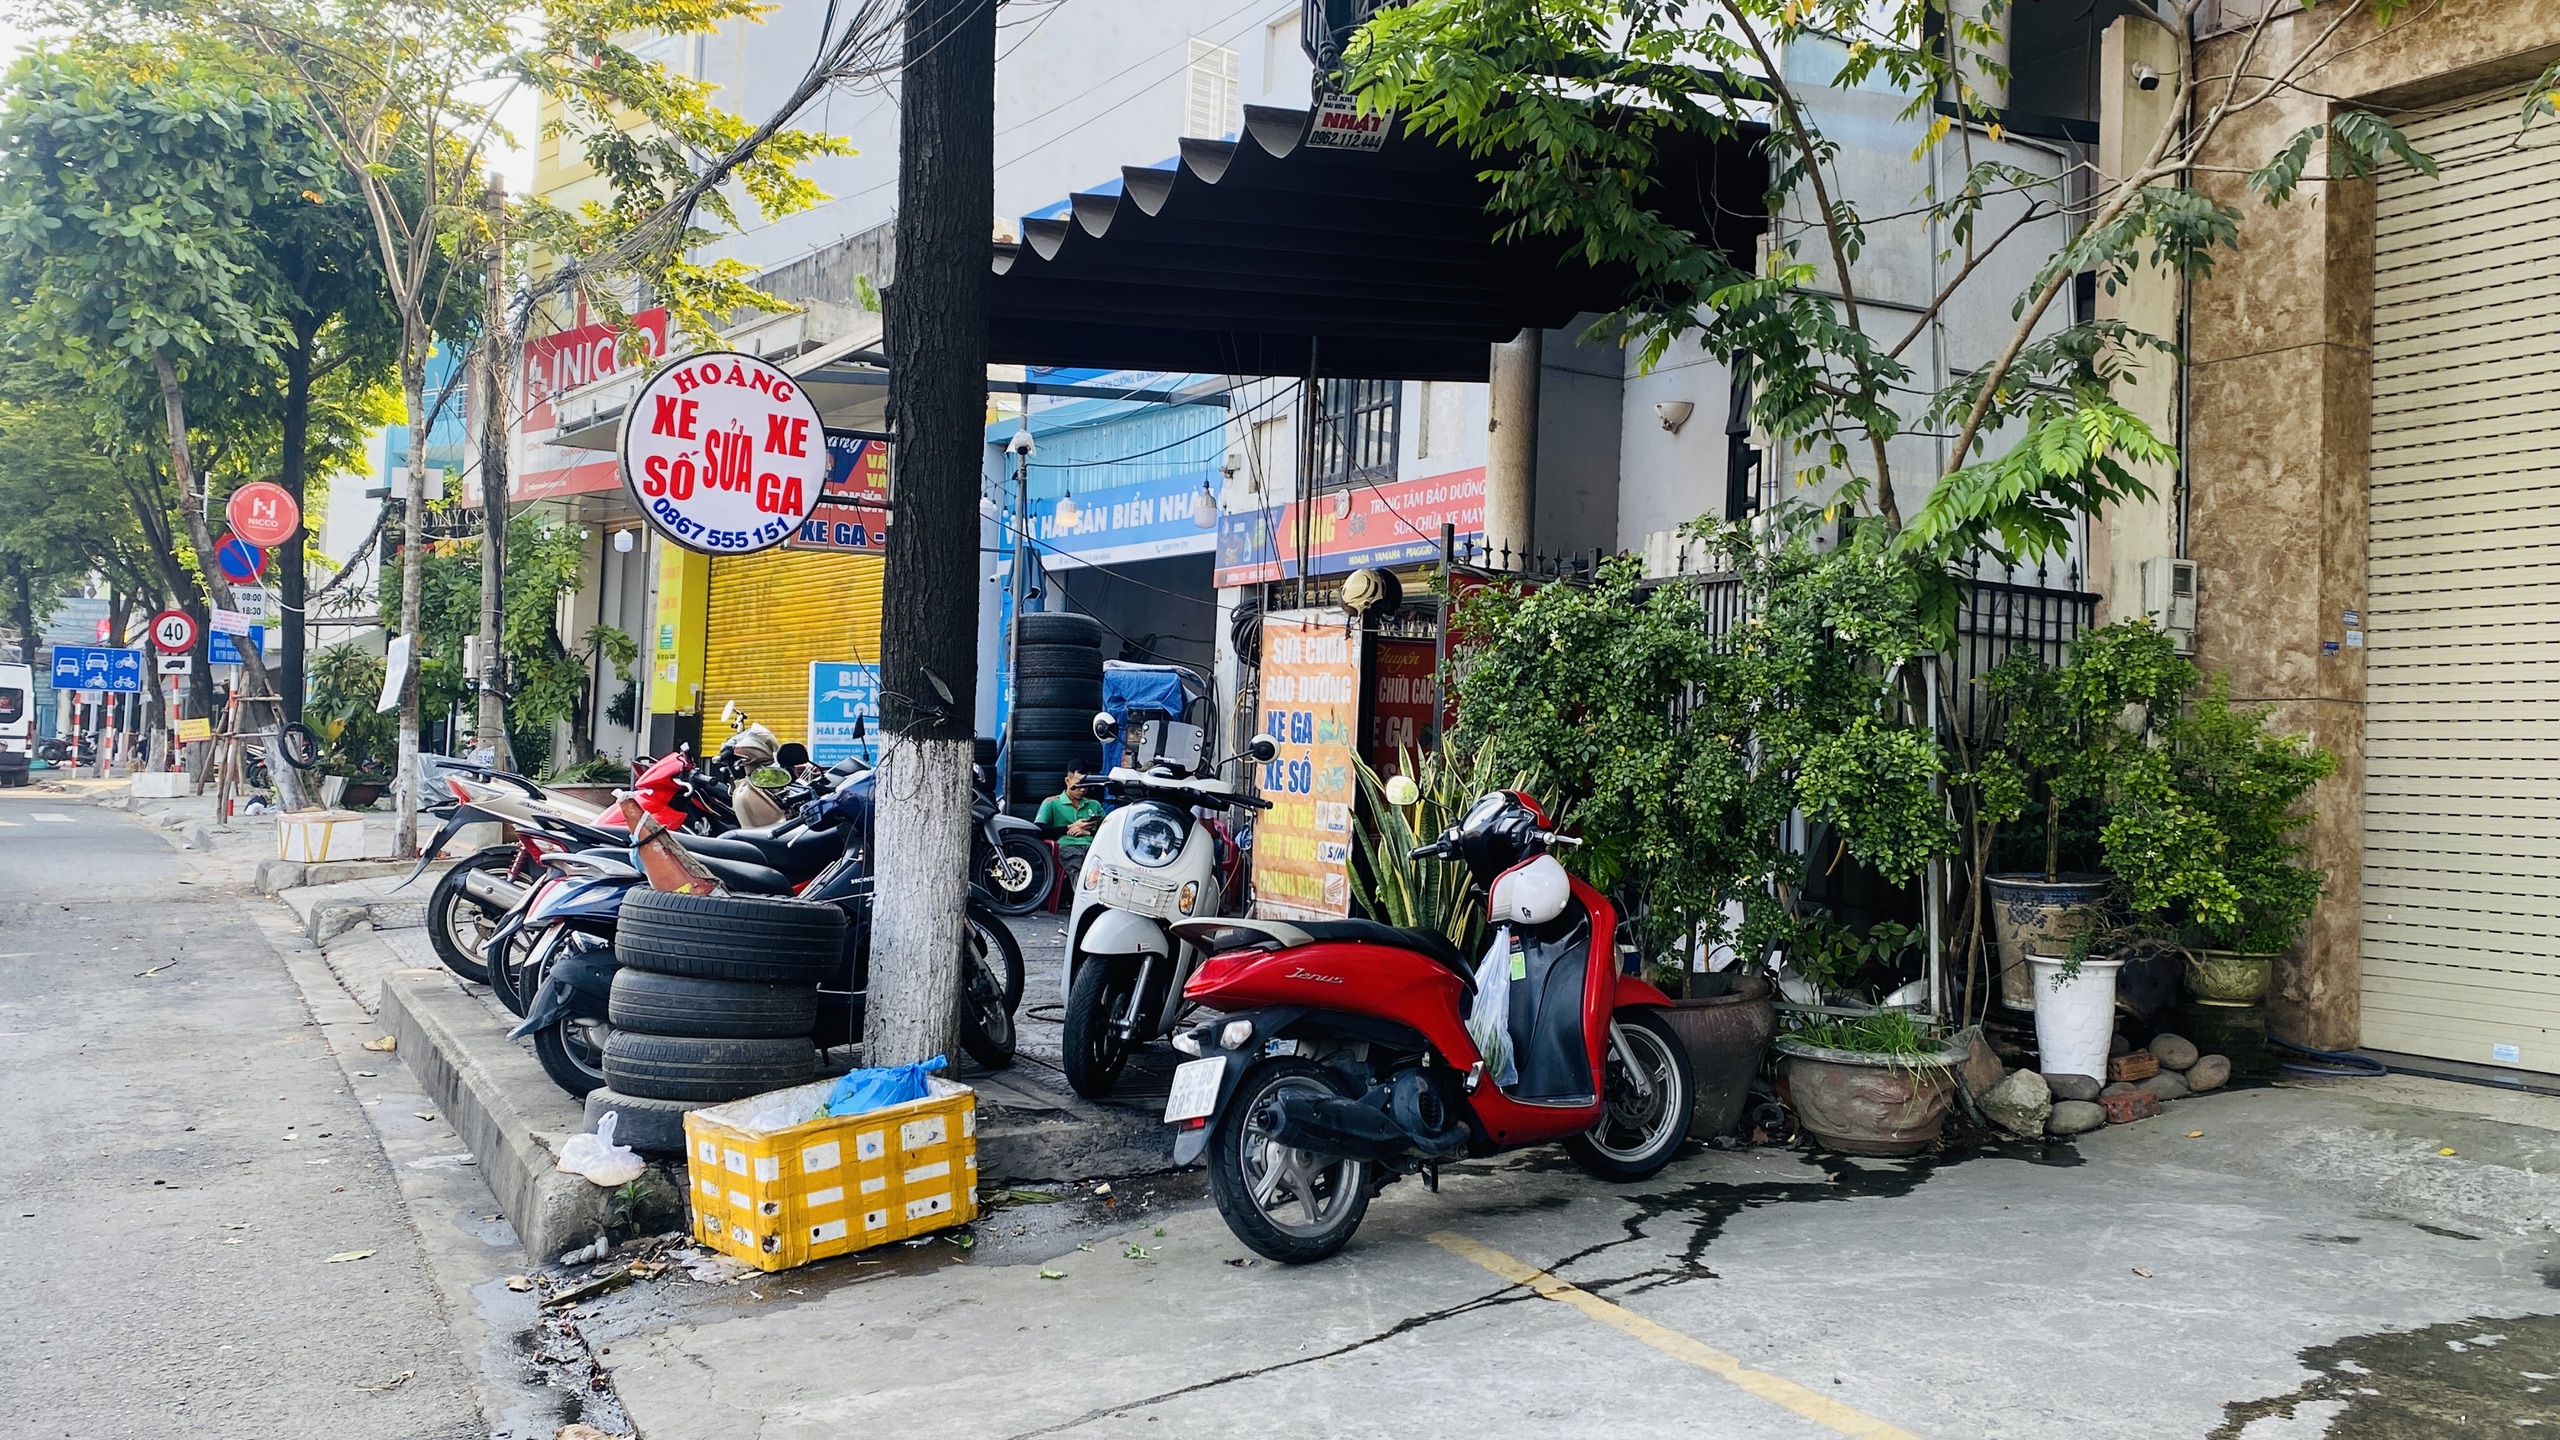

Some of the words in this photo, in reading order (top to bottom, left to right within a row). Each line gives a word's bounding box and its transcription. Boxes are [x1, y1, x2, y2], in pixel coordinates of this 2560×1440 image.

[672, 358, 794, 403] HOÀNG
[652, 394, 699, 441] XE
[764, 413, 809, 458] XE
[702, 418, 753, 494] SỬA
[643, 451, 700, 501] SỐ
[756, 472, 803, 517] GA
[1370, 495, 1401, 515] TRUNG
[1403, 488, 1424, 509] TÂM
[1426, 483, 1447, 504] BẢO
[1450, 479, 1486, 500] DƯỠNG
[247, 517, 279, 528] NICCO
[653, 498, 706, 541] 0867
[706, 529, 749, 549] 555
[752, 516, 790, 545] 151
[1076, 501, 1107, 536] SẢN
[1112, 491, 1154, 529] BIỂN
[1290, 510, 1336, 548] HÀNG
[1393, 514, 1412, 535] SỬA
[1415, 511, 1442, 532] CHỮA
[1445, 511, 1459, 526] XE
[1461, 503, 1485, 525] MÁY
[799, 519, 829, 543] XE
[834, 521, 867, 547] GA
[1375, 549, 1401, 562] YAMAHA
[1405, 545, 1433, 558] PIAGGIO
[242, 592, 262, 602] 08:00
[242, 606, 262, 616] 18:30
[163, 622, 184, 641] 40
[1272, 631, 1302, 665] SỬA
[1305, 633, 1348, 665] CHỮA
[1265, 669, 1295, 703] BẢO
[1299, 672, 1352, 704] DƯỠNG
[1379, 673, 1409, 704] CHỮA
[1411, 676, 1434, 705] CÁC
[816, 724, 835, 736] HẢI
[1267, 710, 1287, 744] XE
[1290, 711, 1314, 745] GA
[1385, 716, 1413, 748] GA
[1263, 759, 1285, 792] XE
[1287, 750, 1313, 795] SỐ
[1327, 822, 1346, 831] SUZUKI
[850, 876, 875, 885] HOND
